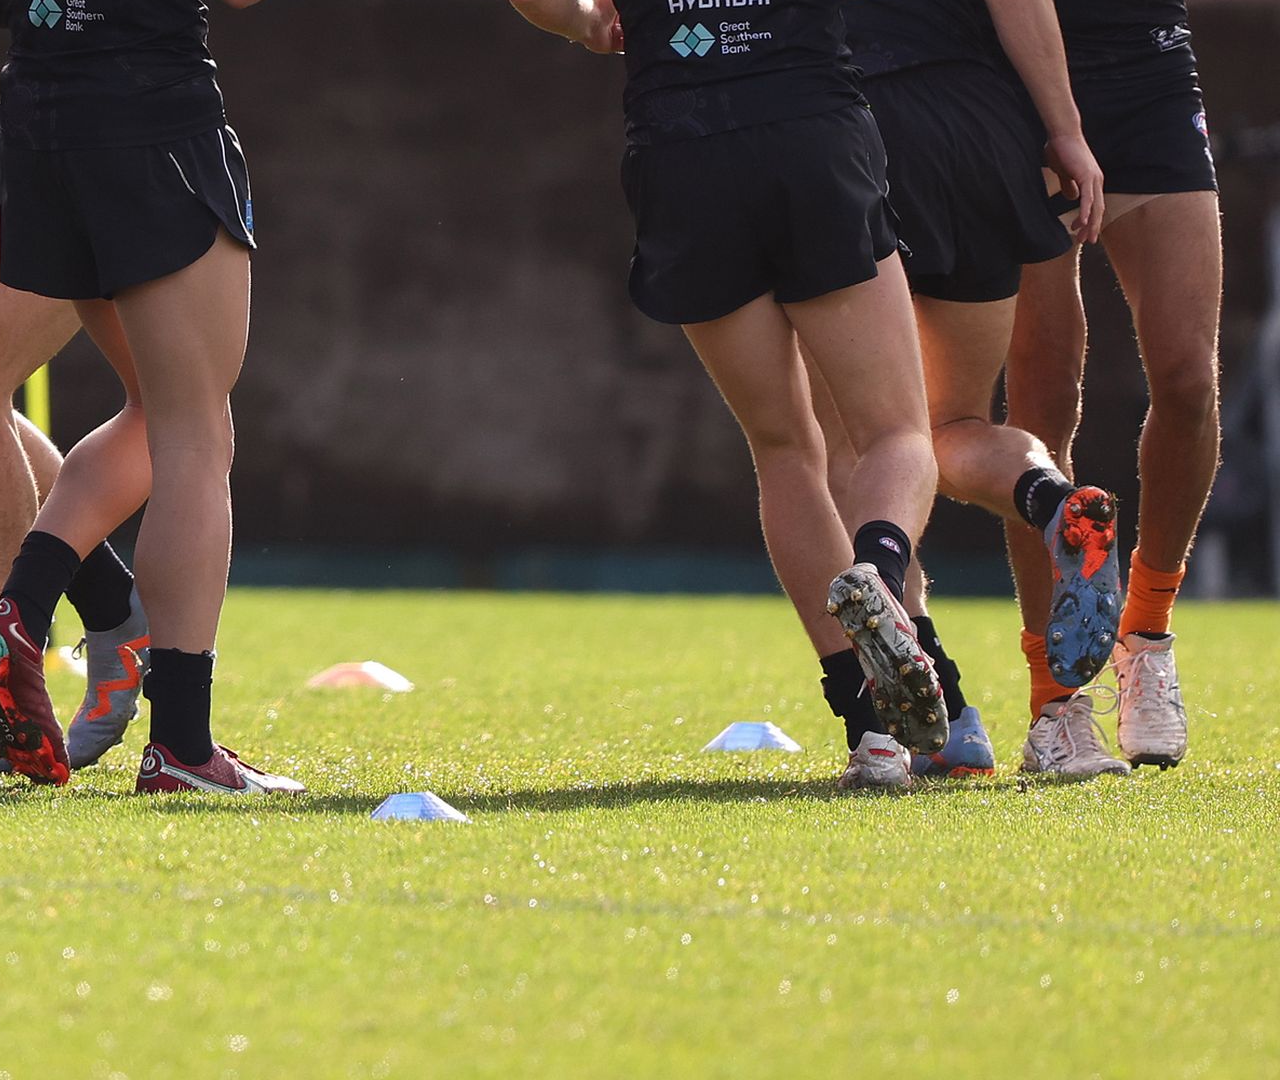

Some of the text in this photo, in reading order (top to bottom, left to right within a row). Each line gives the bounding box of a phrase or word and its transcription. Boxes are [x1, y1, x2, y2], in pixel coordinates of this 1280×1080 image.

[66, 8, 105, 21] Southern
[65, 20, 84, 32] Bank
[719, 21, 751, 33] Great
[720, 32, 772, 45] Southern
[721, 44, 751, 55] Bank
